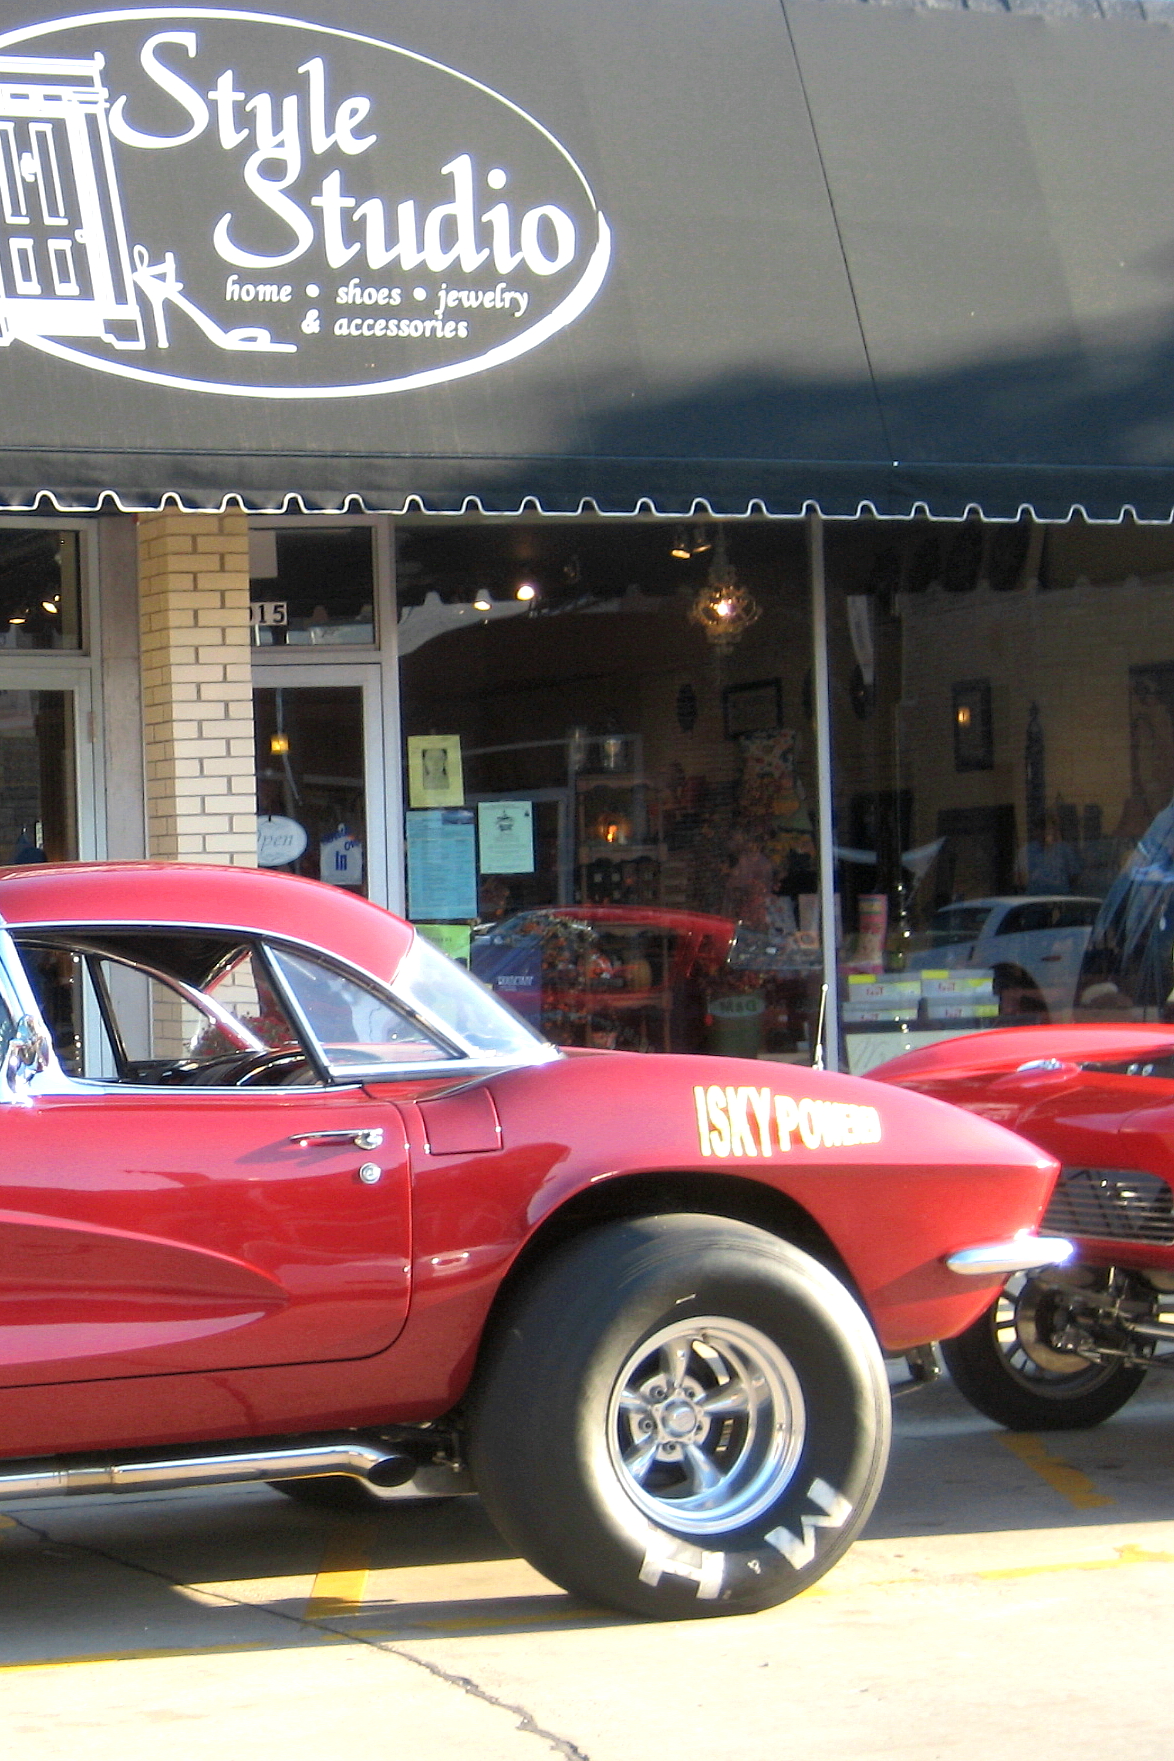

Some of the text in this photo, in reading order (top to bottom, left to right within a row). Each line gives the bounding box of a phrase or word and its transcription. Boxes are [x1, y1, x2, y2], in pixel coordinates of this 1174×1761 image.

[108, 31, 377, 185] Style
[213, 150, 575, 276] Studio
[226, 274, 529, 318] home shoes jewelry
[301, 308, 469, 338] & accessories
[257, 829, 294, 852] pen
[335, 850, 347, 871] In
[693, 1084, 773, 1158] ISKY
